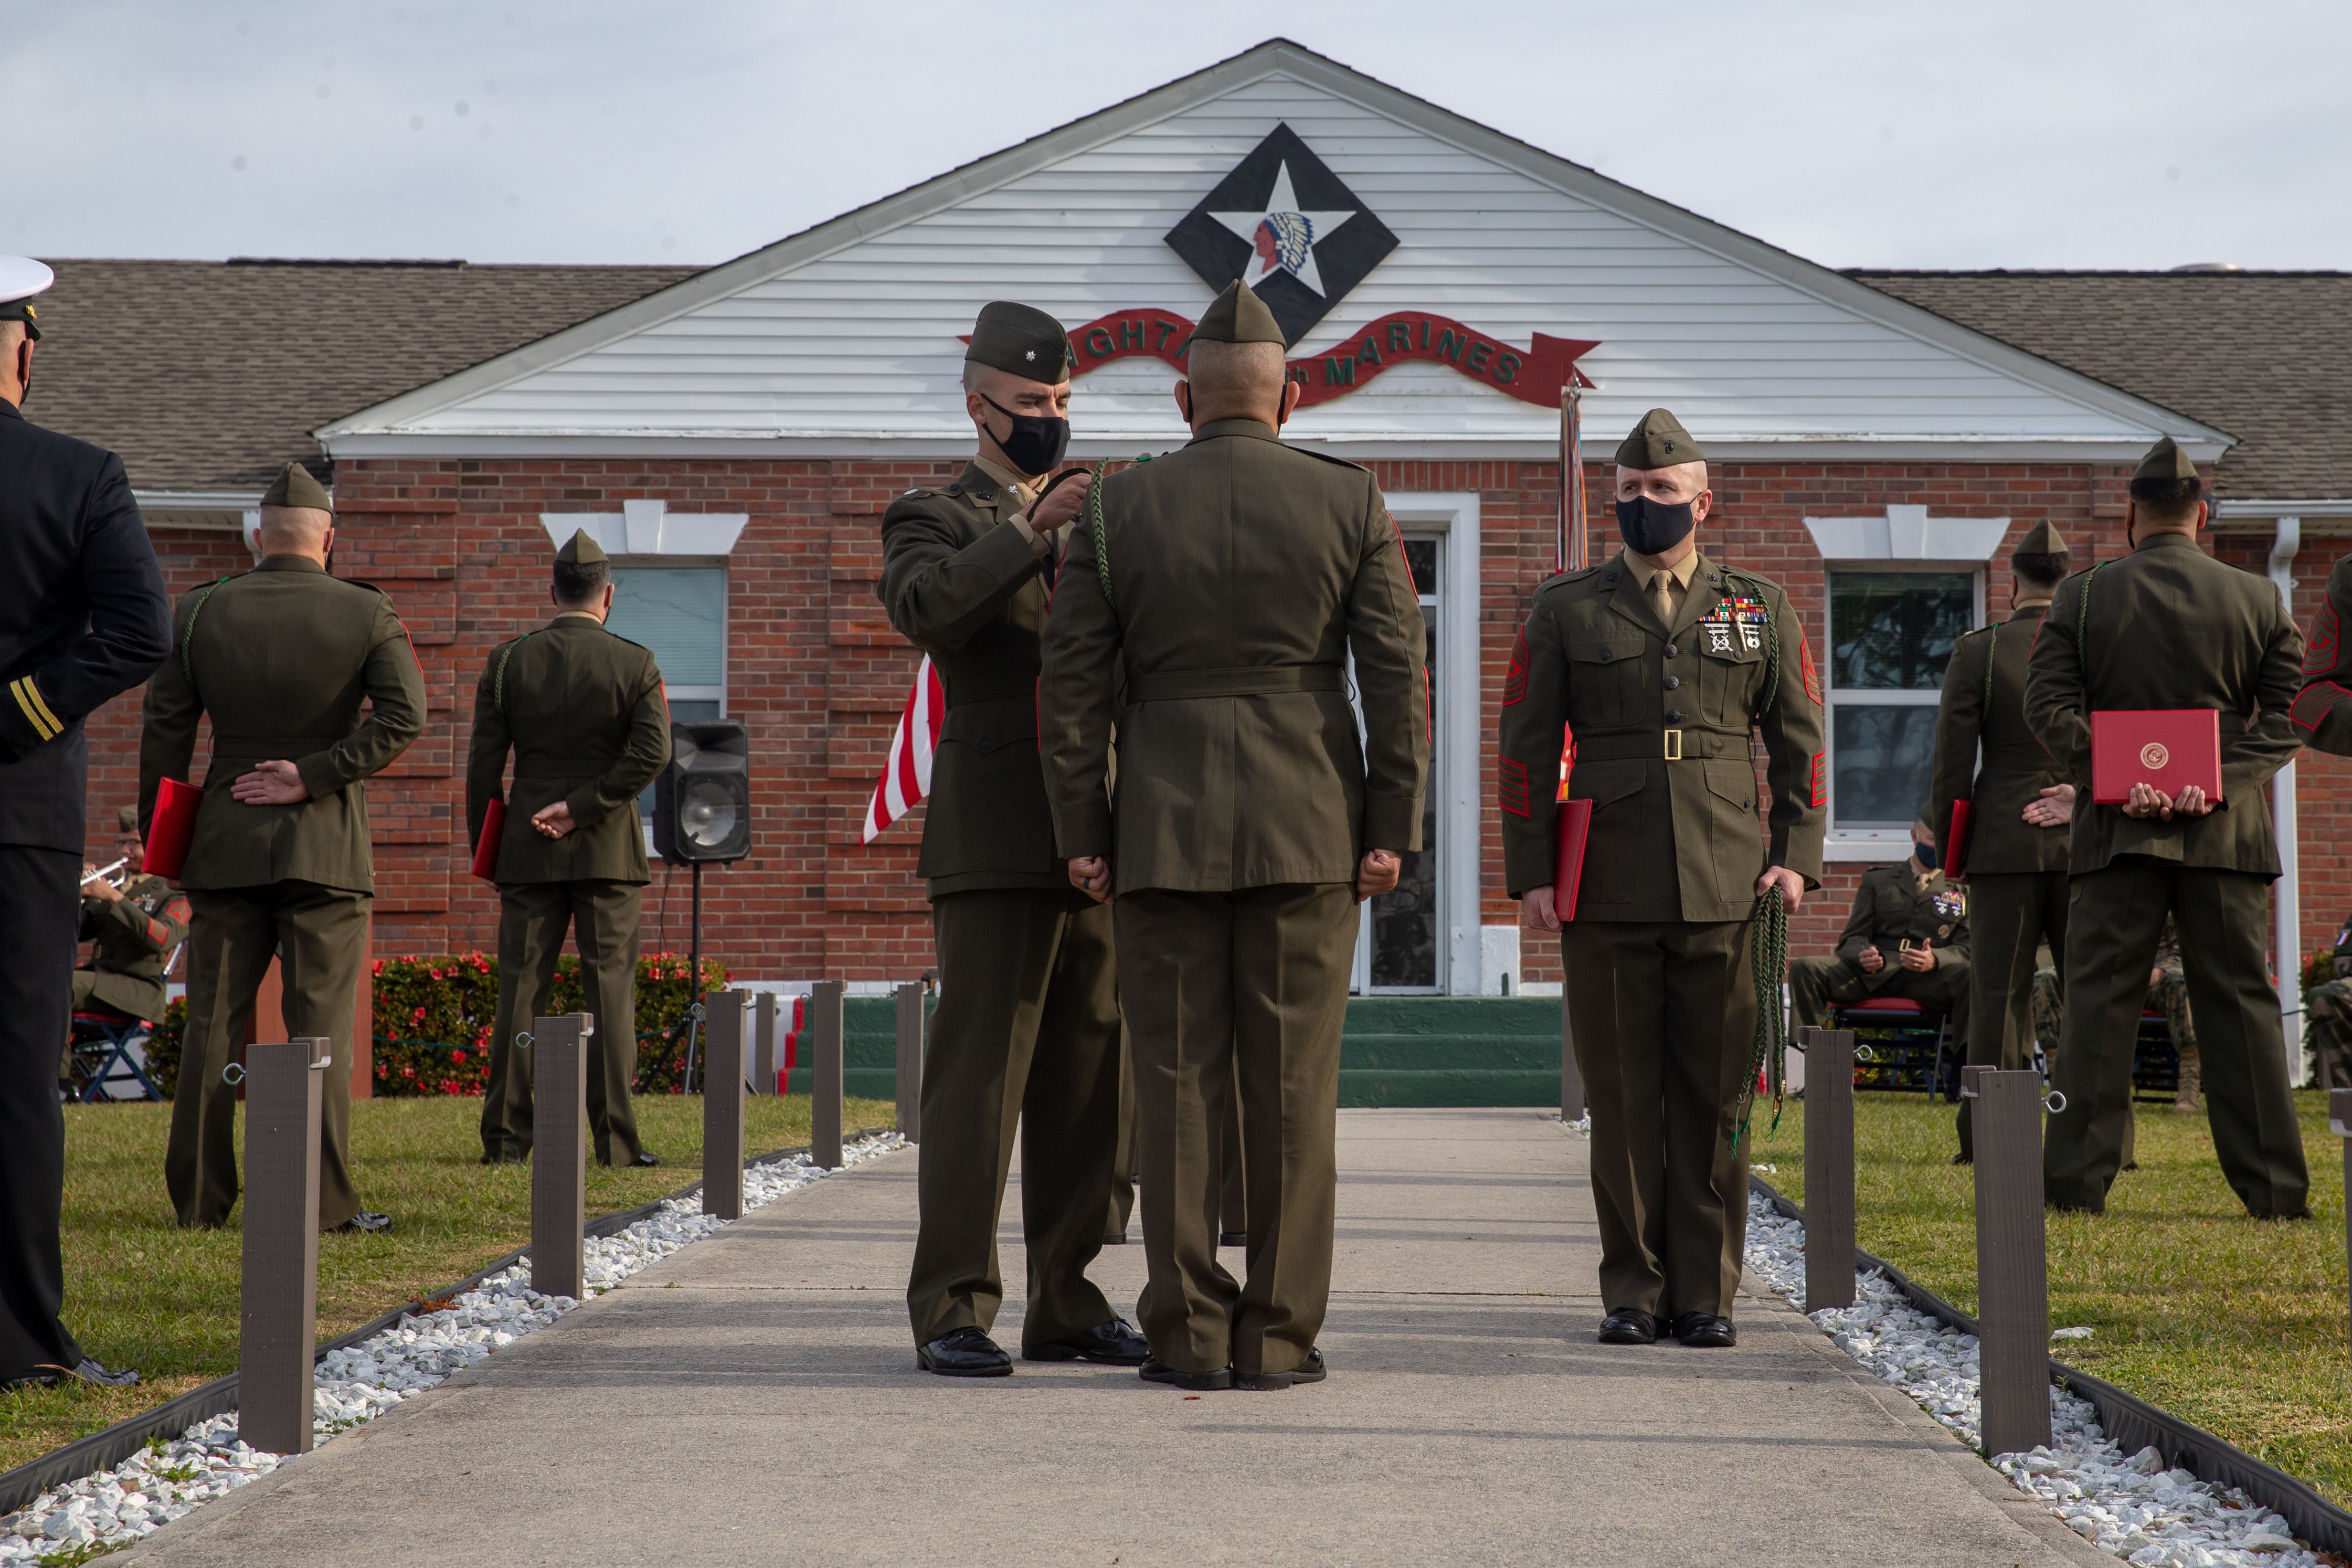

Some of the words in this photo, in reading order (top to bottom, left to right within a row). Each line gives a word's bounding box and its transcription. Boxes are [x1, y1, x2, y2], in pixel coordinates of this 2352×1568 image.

[1068, 319, 1190, 367] IGHTI
[1285, 366, 1309, 384] th
[1325, 320, 1522, 385] MARINES
